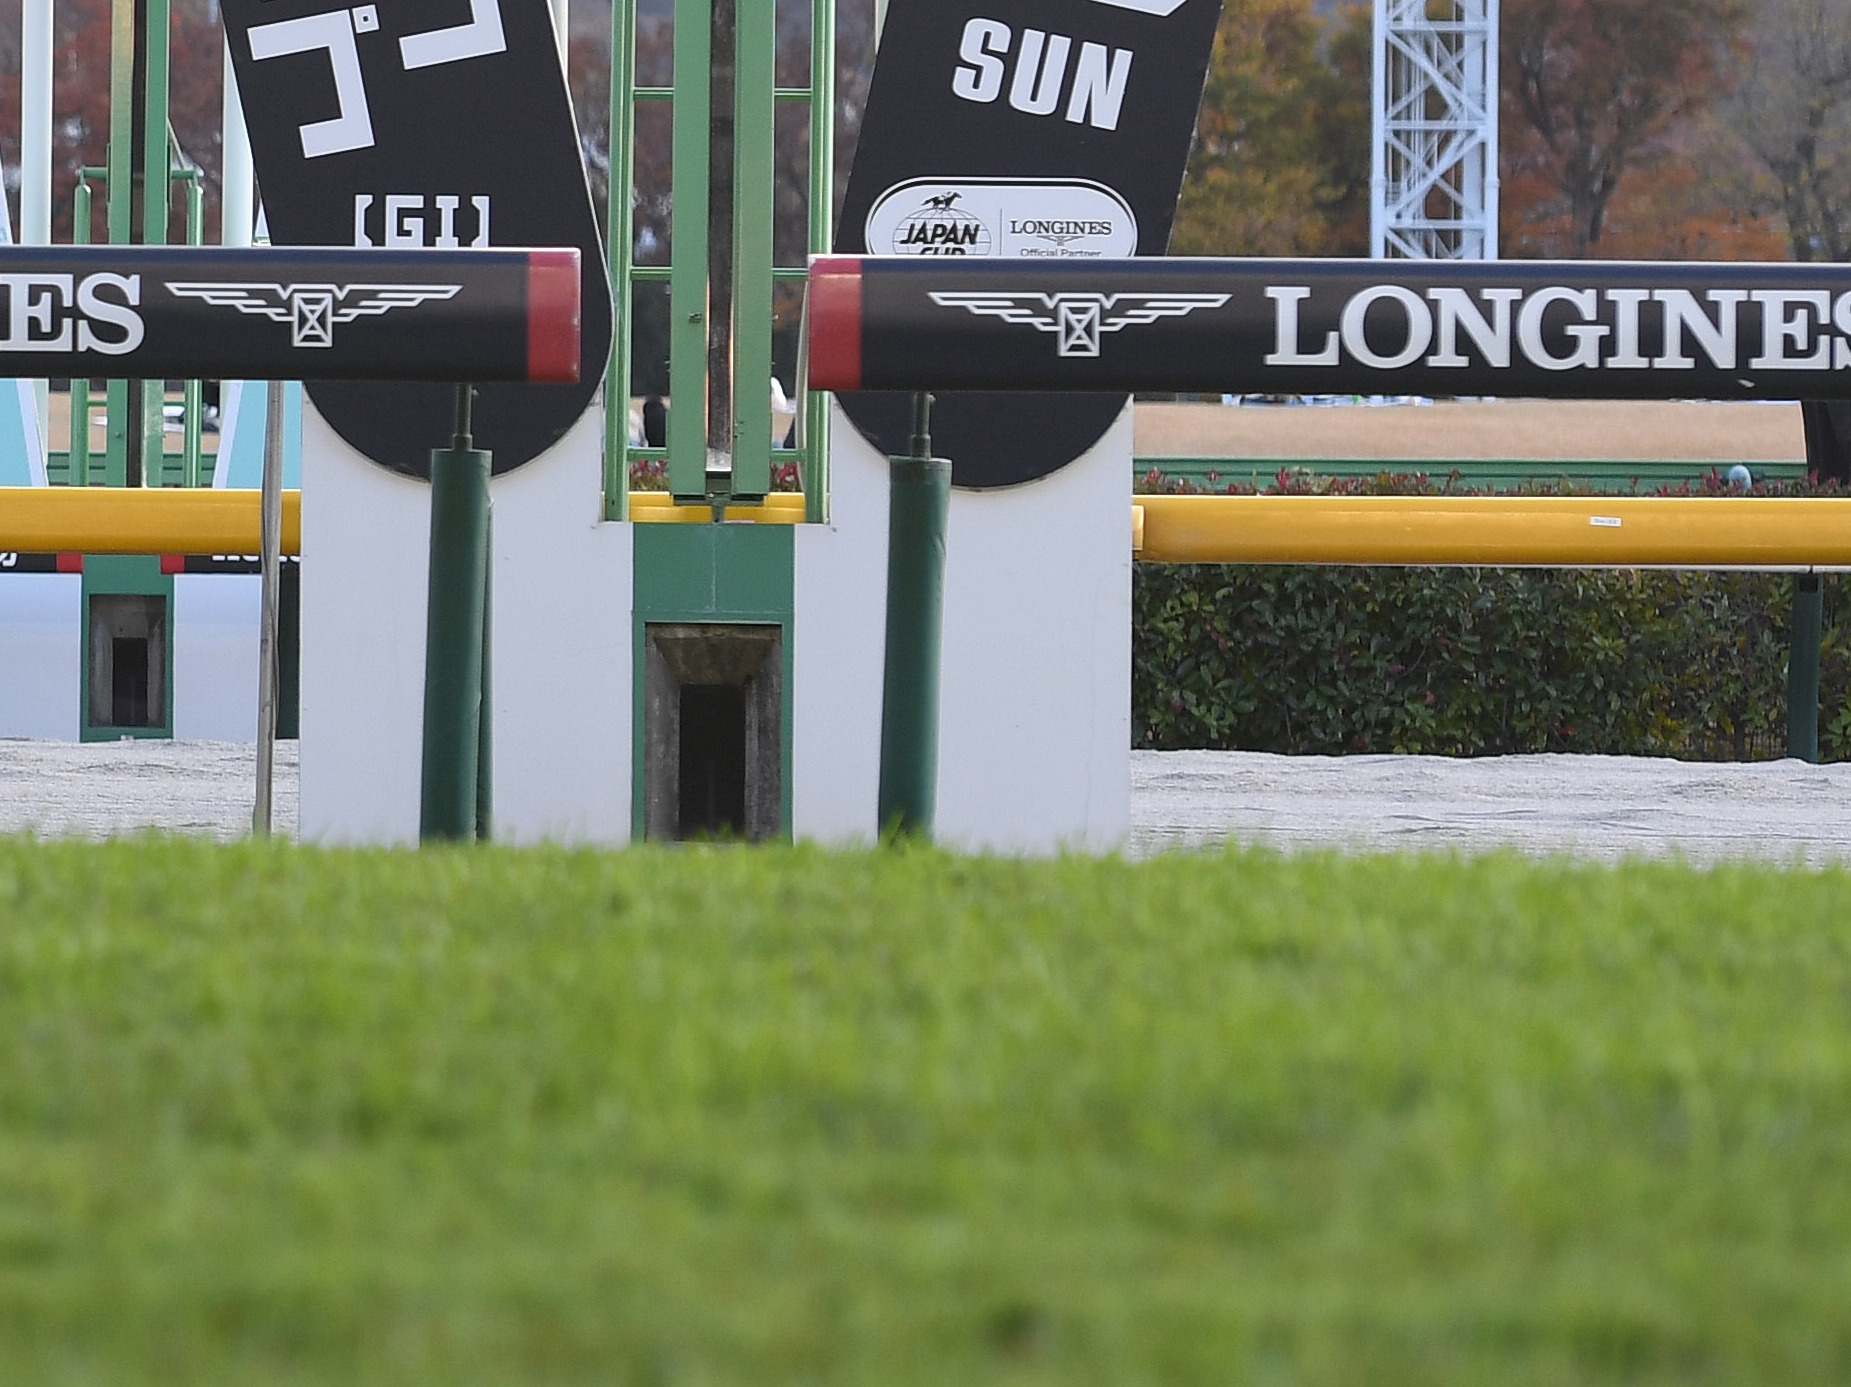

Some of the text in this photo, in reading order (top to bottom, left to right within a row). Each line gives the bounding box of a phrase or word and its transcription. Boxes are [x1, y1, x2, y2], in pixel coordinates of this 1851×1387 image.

[953, 17, 1134, 131] SUN
[899, 220, 980, 246] JAPAN
[1010, 220, 1112, 236] LONGINES
